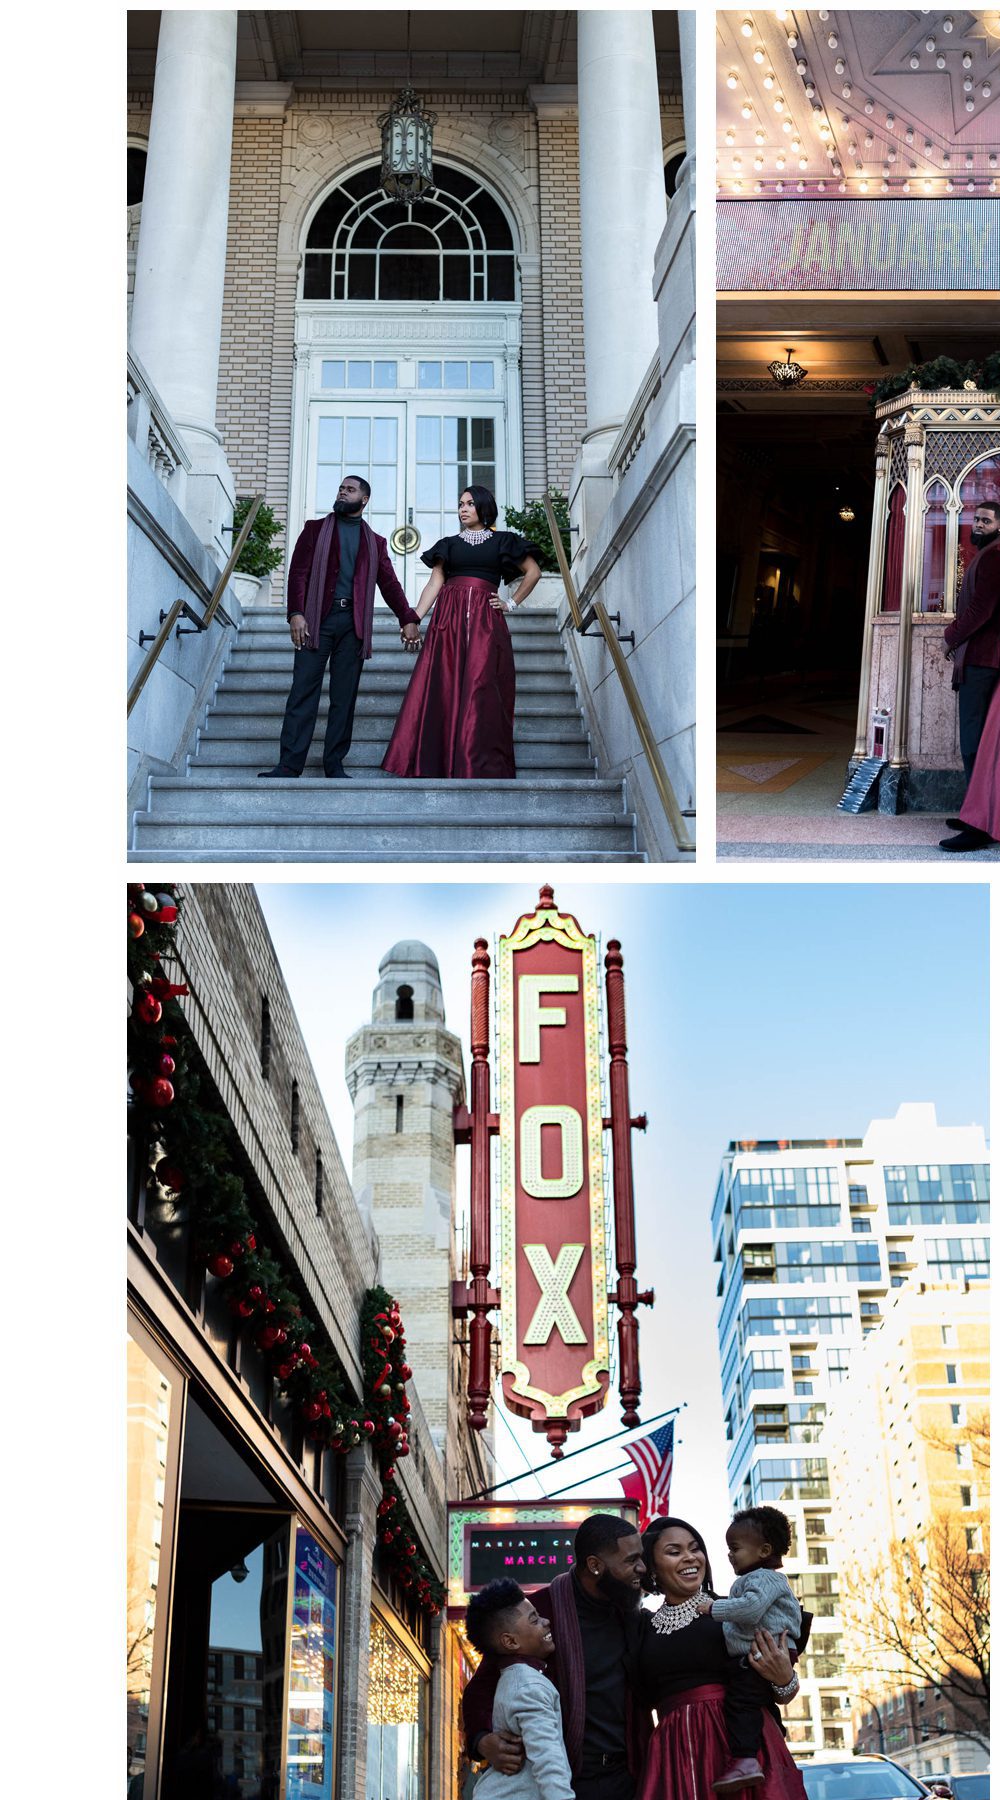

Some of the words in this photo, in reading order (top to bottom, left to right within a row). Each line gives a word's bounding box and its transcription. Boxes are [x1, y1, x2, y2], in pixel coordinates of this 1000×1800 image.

[780, 221, 988, 271] JANUARY
[519, 974, 588, 1345] FOX
[505, 1556, 557, 1565] MARCH
